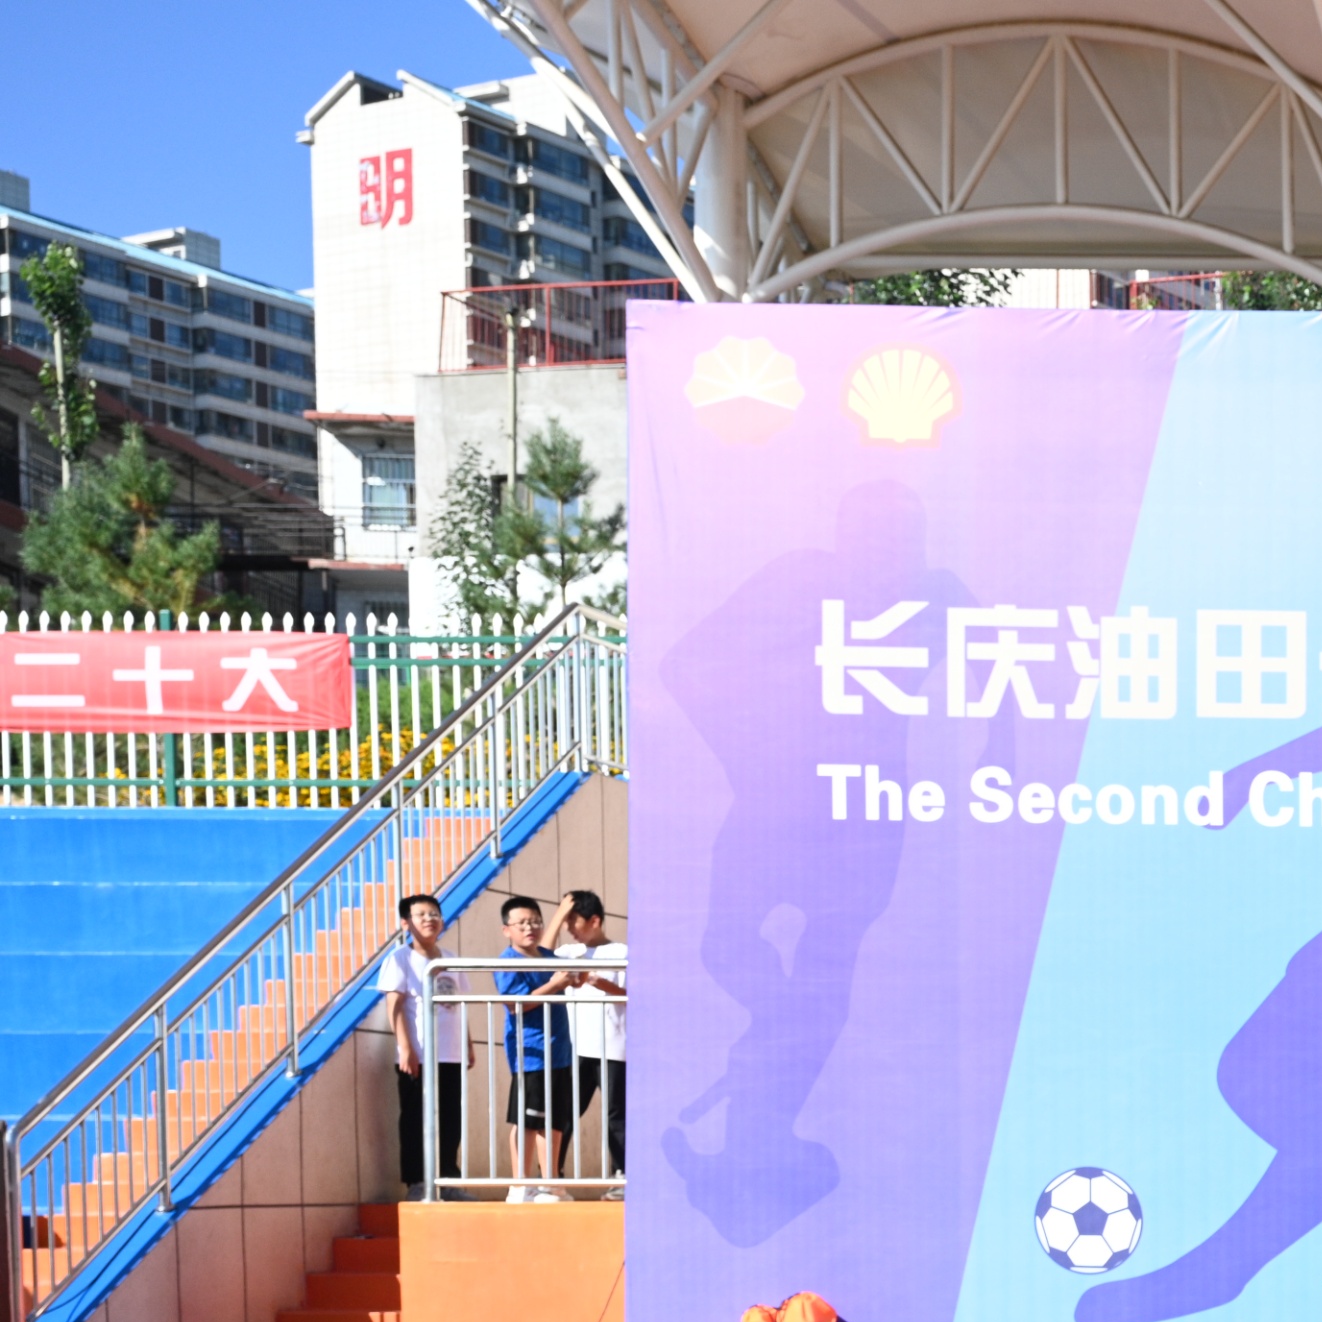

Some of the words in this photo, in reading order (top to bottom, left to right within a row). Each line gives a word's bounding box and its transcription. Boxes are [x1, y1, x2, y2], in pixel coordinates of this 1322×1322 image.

[11, 645, 299, 713] 二十大
[816, 763, 946, 821] The
[969, 765, 1224, 826] Second
